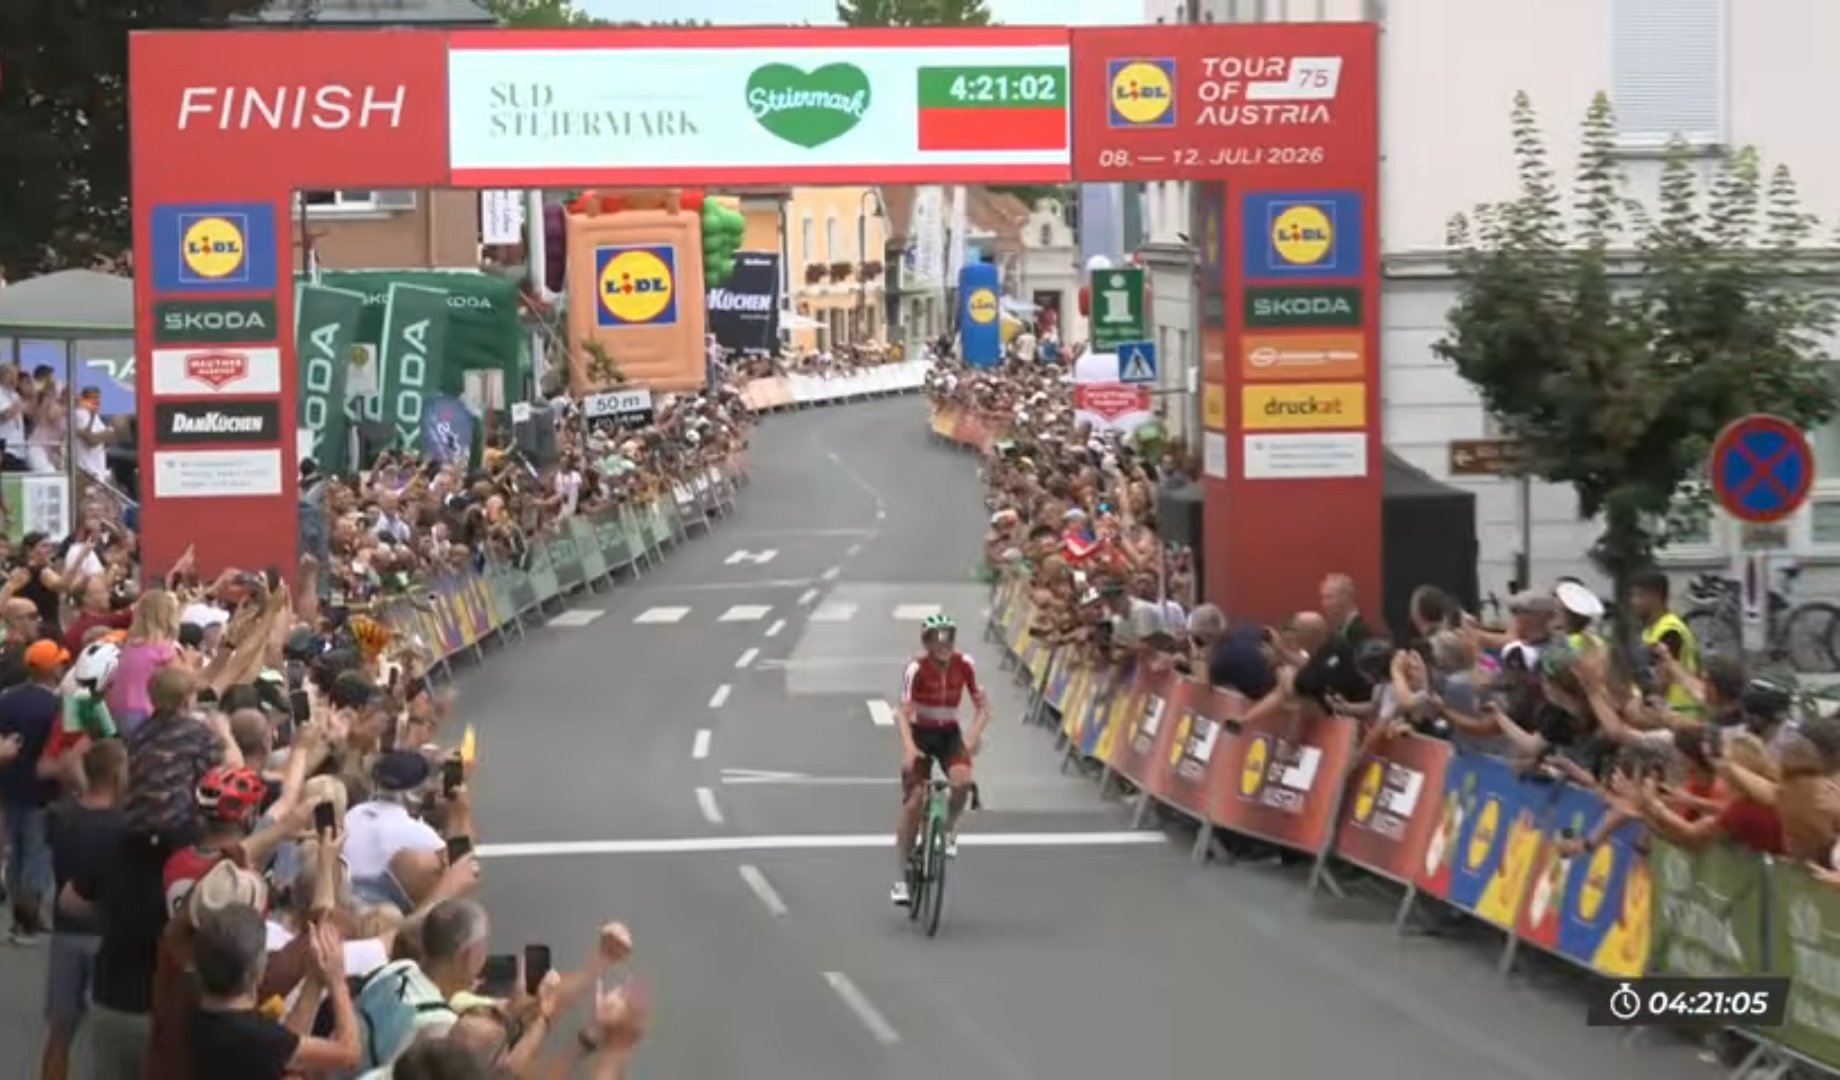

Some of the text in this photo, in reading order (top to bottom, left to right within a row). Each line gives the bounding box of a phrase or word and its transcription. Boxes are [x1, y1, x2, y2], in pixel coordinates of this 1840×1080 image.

[1201, 57, 1329, 88] TOUR 75
[949, 75, 1056, 100] 4:21:02
[1198, 81, 1241, 101] OF
[176, 85, 406, 129] FINISH
[748, 86, 866, 119] Steiermark
[1195, 105, 1331, 125] AUSTRIA
[489, 110, 700, 138] STEIERMARK
[1098, 150, 1134, 167] 08.
[1209, 149, 1262, 164] JULI
[1266, 147, 1325, 164] 2026
[596, 395, 641, 412] 50 m
